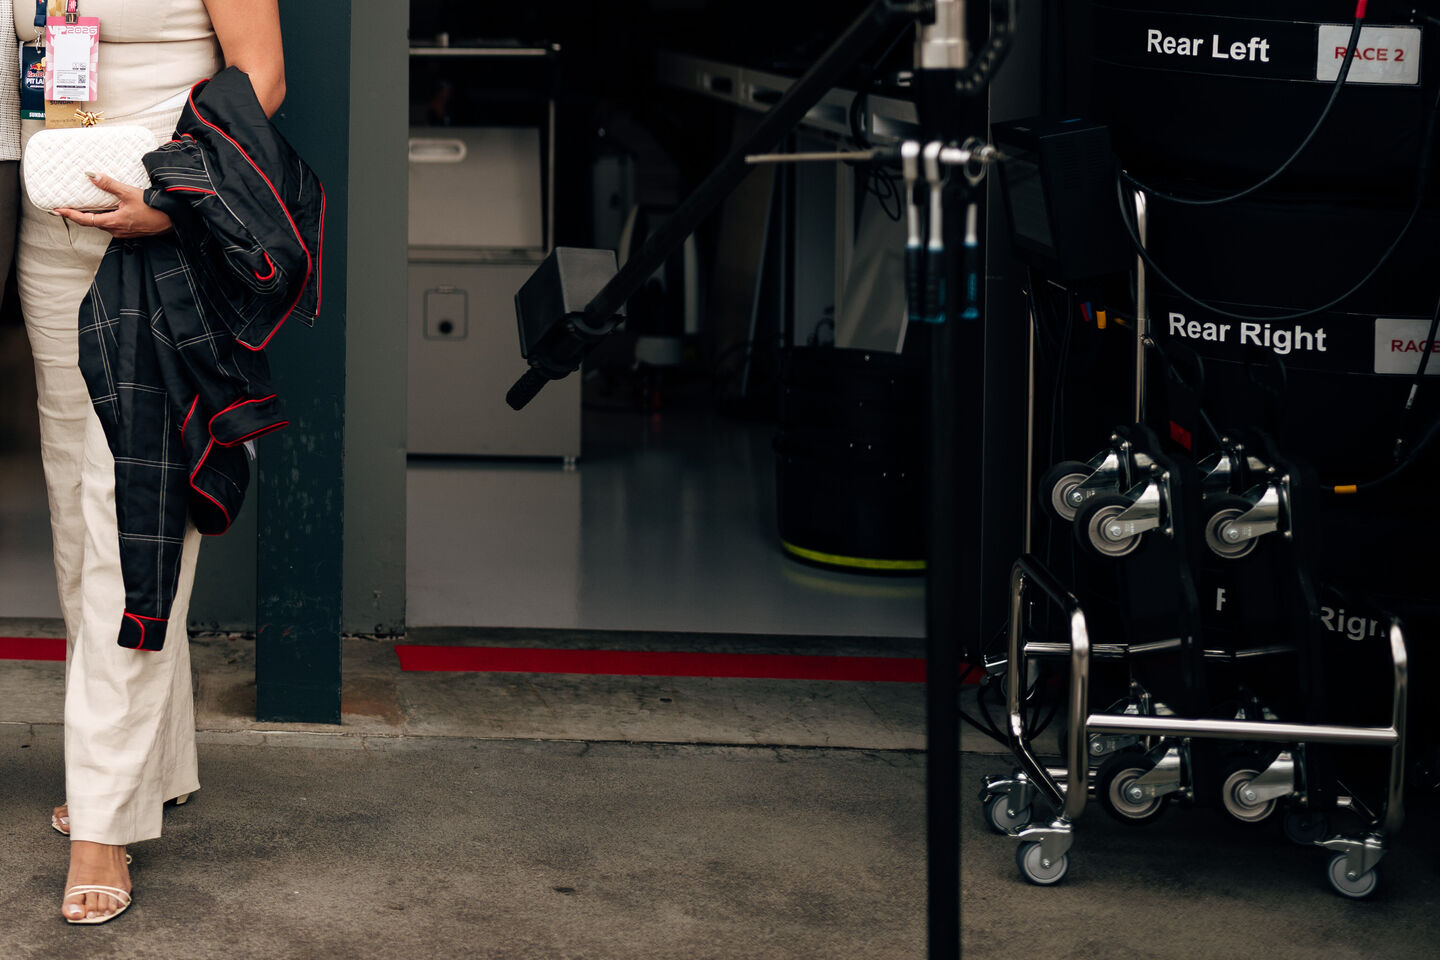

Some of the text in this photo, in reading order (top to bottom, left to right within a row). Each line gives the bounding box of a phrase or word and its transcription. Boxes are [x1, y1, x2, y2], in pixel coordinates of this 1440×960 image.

[1147, 28, 1270, 63] Rear Left
[1335, 46, 1405, 62] RACE 2
[1168, 312, 1327, 355] Rear Right
[1321, 606, 1386, 641] Rig
